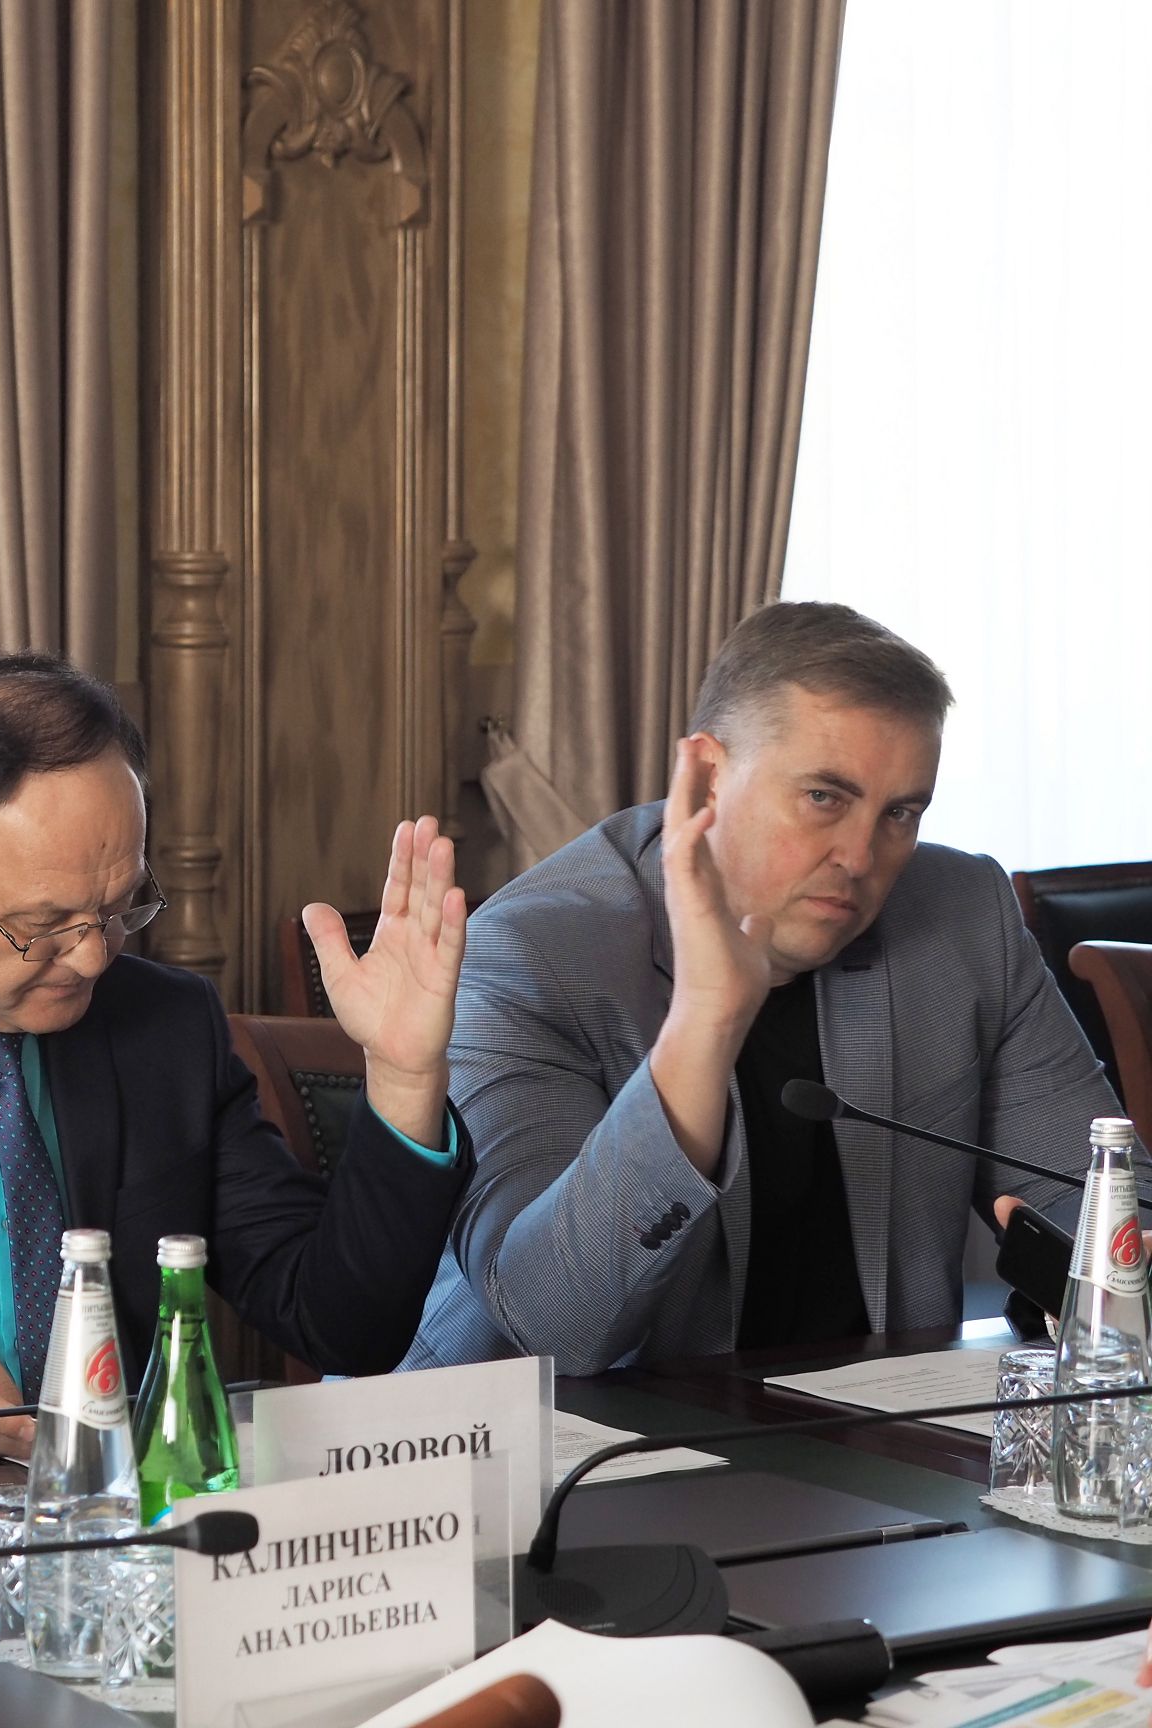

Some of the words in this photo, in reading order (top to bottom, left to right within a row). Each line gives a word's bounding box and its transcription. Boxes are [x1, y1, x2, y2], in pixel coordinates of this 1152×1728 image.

[318, 1422, 492, 1477] ЛОЗОВОЙ
[210, 1511, 460, 1582] КАЛИНЧЕНКО
[281, 1570, 392, 1611] ЛАРИСА
[235, 1600, 439, 1659] АНАТОЛЬЕВНА
